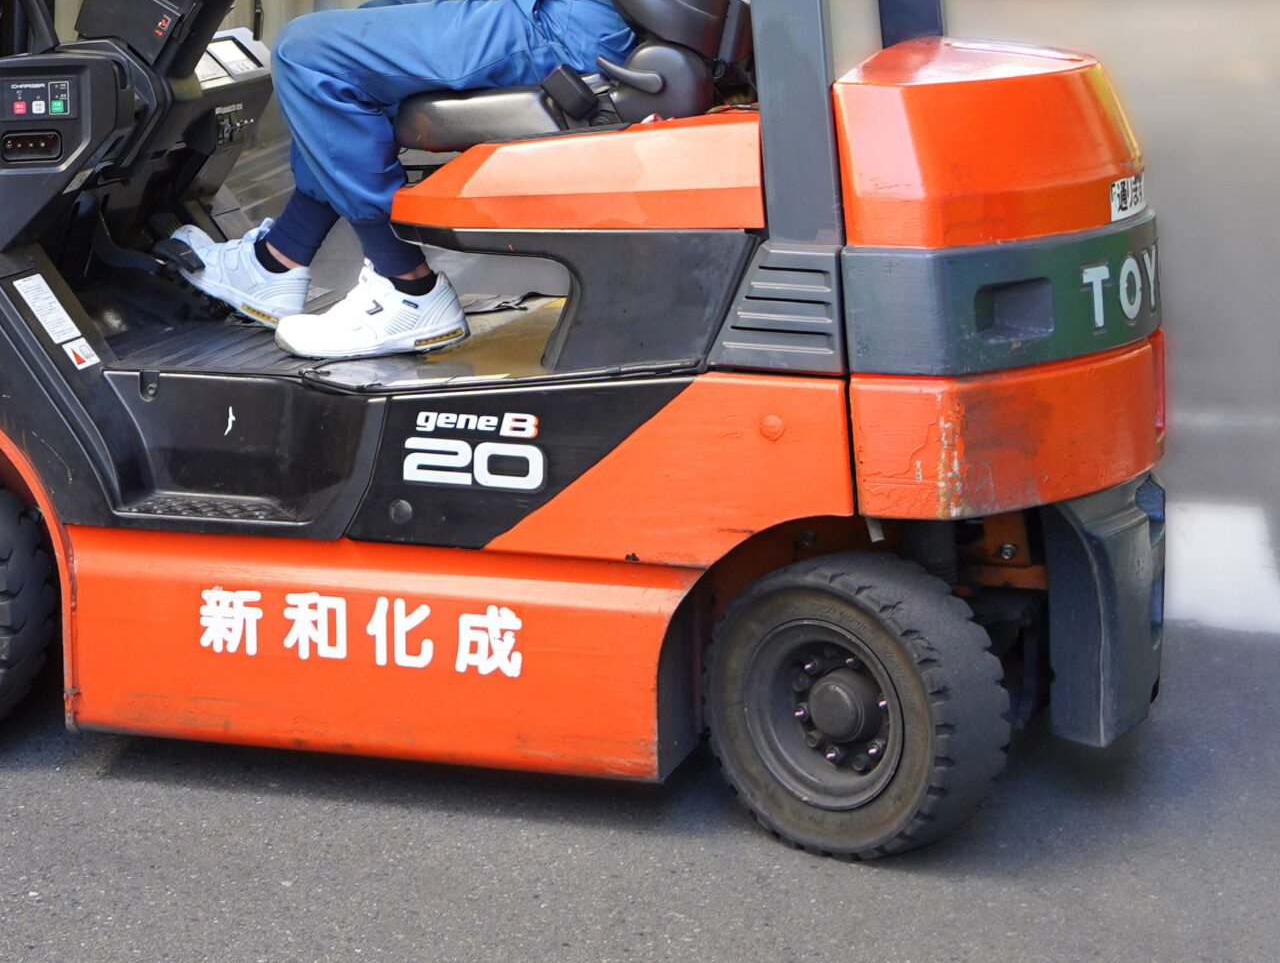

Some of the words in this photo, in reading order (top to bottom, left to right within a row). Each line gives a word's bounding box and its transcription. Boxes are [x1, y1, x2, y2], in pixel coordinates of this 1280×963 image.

[403, 436, 544, 490] 20
[199, 586, 523, 678] 新和化成
